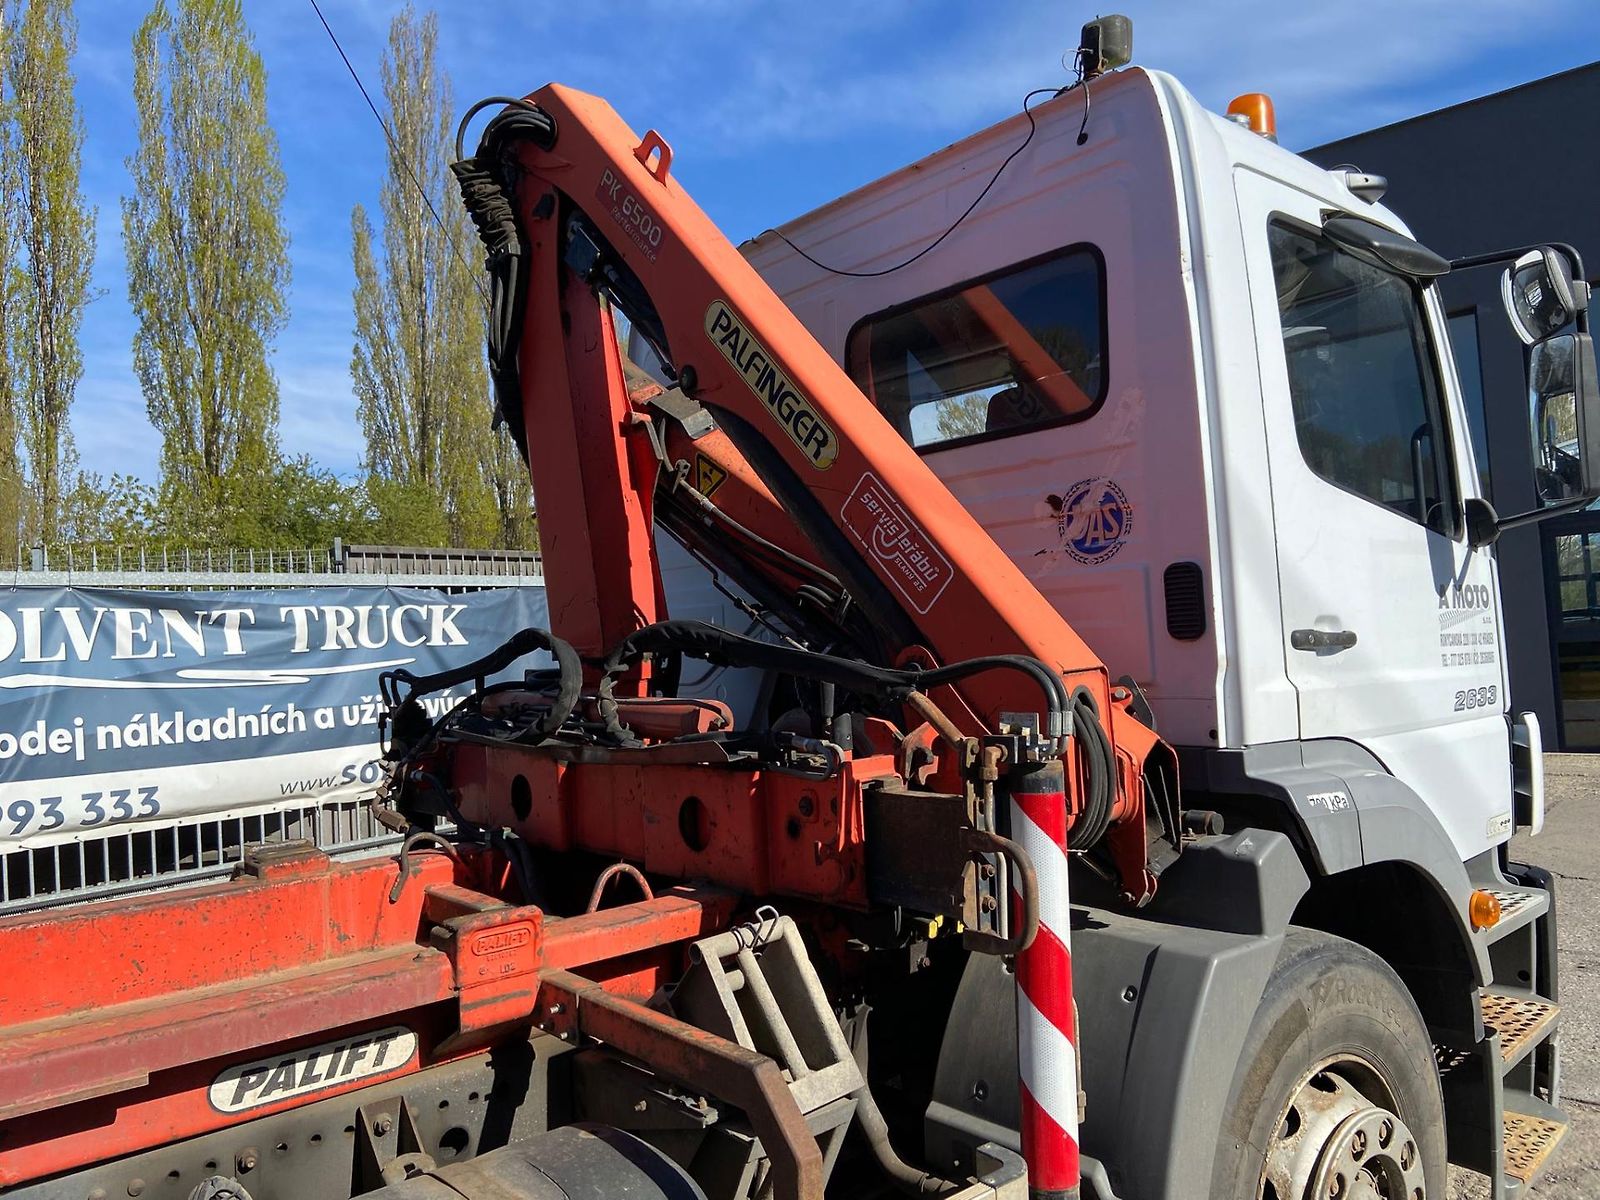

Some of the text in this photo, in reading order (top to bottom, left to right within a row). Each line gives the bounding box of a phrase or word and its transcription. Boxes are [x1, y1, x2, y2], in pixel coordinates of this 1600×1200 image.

[600, 168, 662, 247] PK 6500
[710, 308, 829, 460] PALFINGER
[1452, 584, 1490, 609] MOTO
[280, 603, 470, 654] TRUCK
[1454, 685, 1497, 712] 2633
[96, 703, 307, 750] nákladních
[313, 707, 335, 731] a
[280, 763, 387, 796] www.so
[0, 785, 161, 836] 93 333
[230, 1032, 400, 1106] PALIFT
